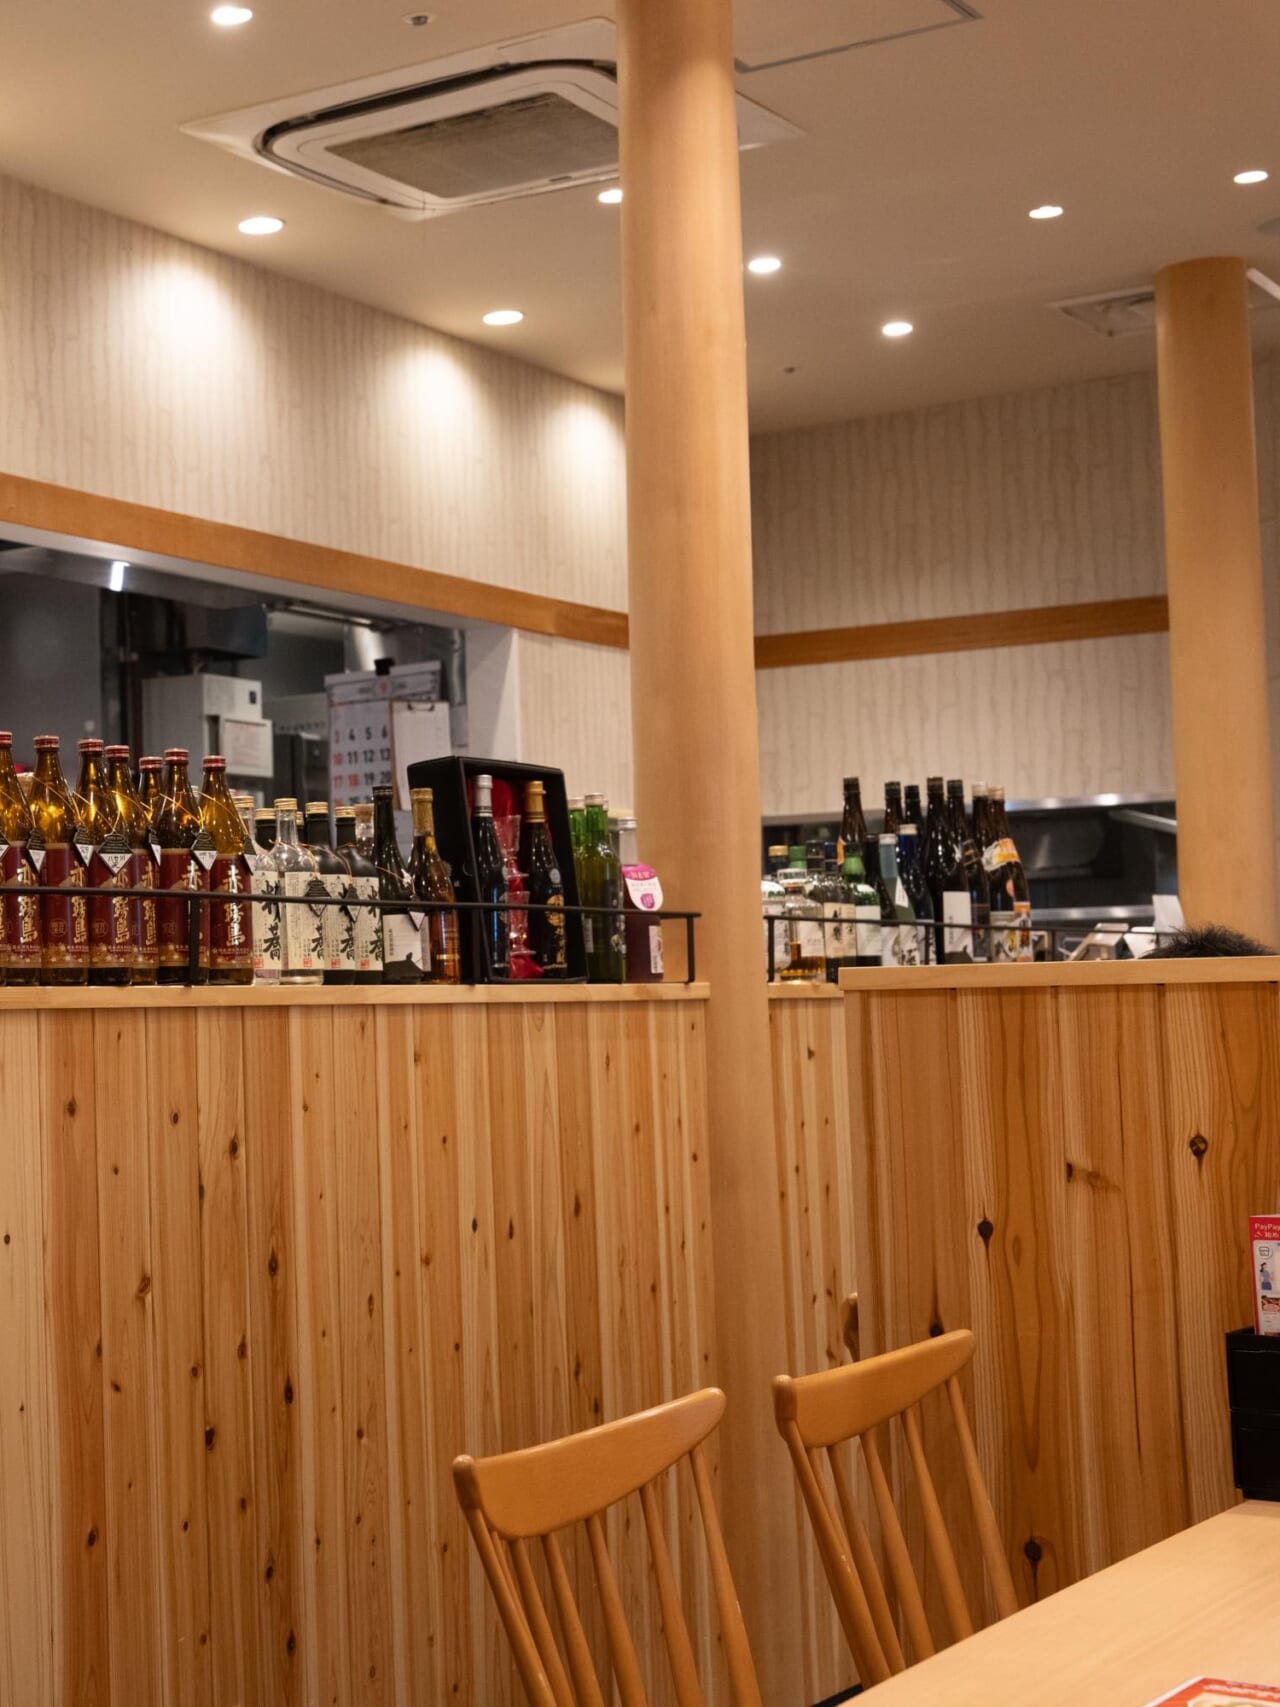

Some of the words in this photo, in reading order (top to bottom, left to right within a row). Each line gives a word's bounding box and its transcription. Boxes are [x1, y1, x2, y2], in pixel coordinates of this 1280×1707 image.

[348, 728, 356, 741] 4
[365, 726, 372, 740] 5
[381, 725, 389, 739] 6
[347, 751, 358, 764] 11
[363, 749, 375, 763] 12
[380, 748, 391, 761] 13
[364, 772, 375, 786] 19
